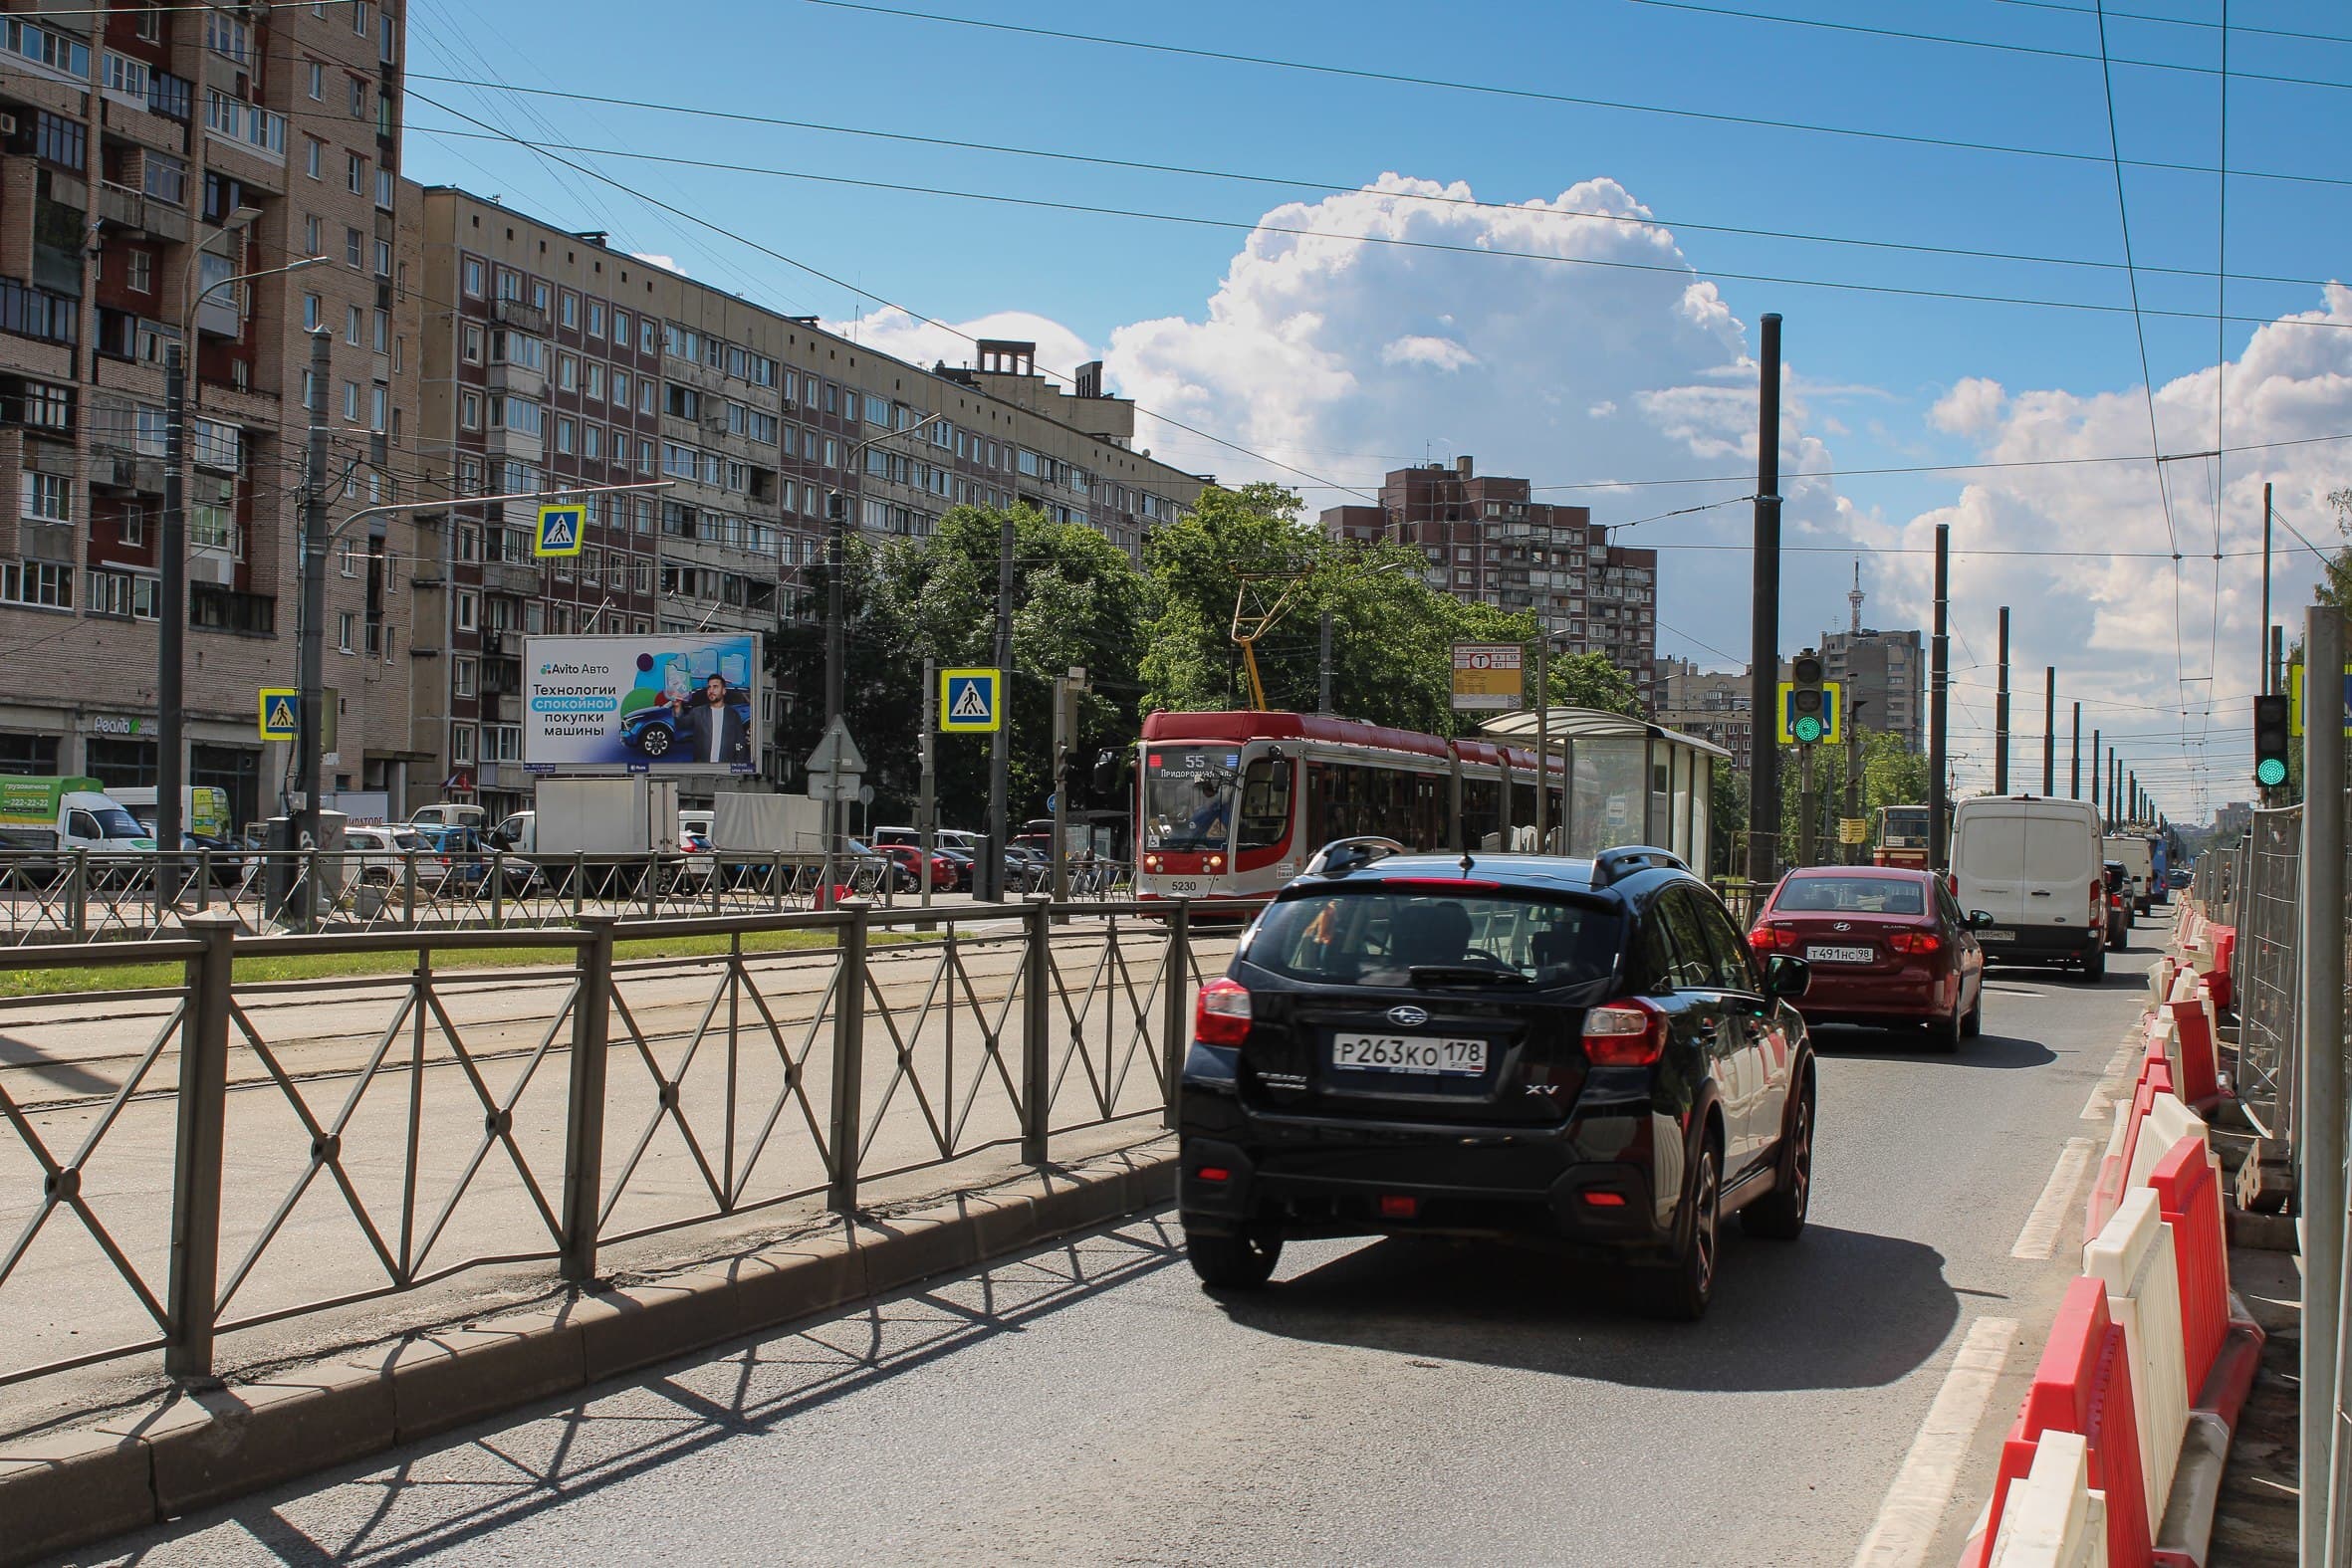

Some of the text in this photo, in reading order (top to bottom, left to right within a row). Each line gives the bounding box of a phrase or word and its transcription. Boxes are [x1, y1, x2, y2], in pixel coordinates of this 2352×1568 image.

[552, 663, 609, 674] Avito Авто
[533, 684, 616, 696] Технологии
[535, 696, 613, 709] спокойной
[545, 713, 604, 726] покупки
[544, 727, 604, 736] машины
[1185, 755, 1205, 769] 55
[1172, 881, 1197, 892] 5230
[1525, 1084, 1560, 1095] XV
